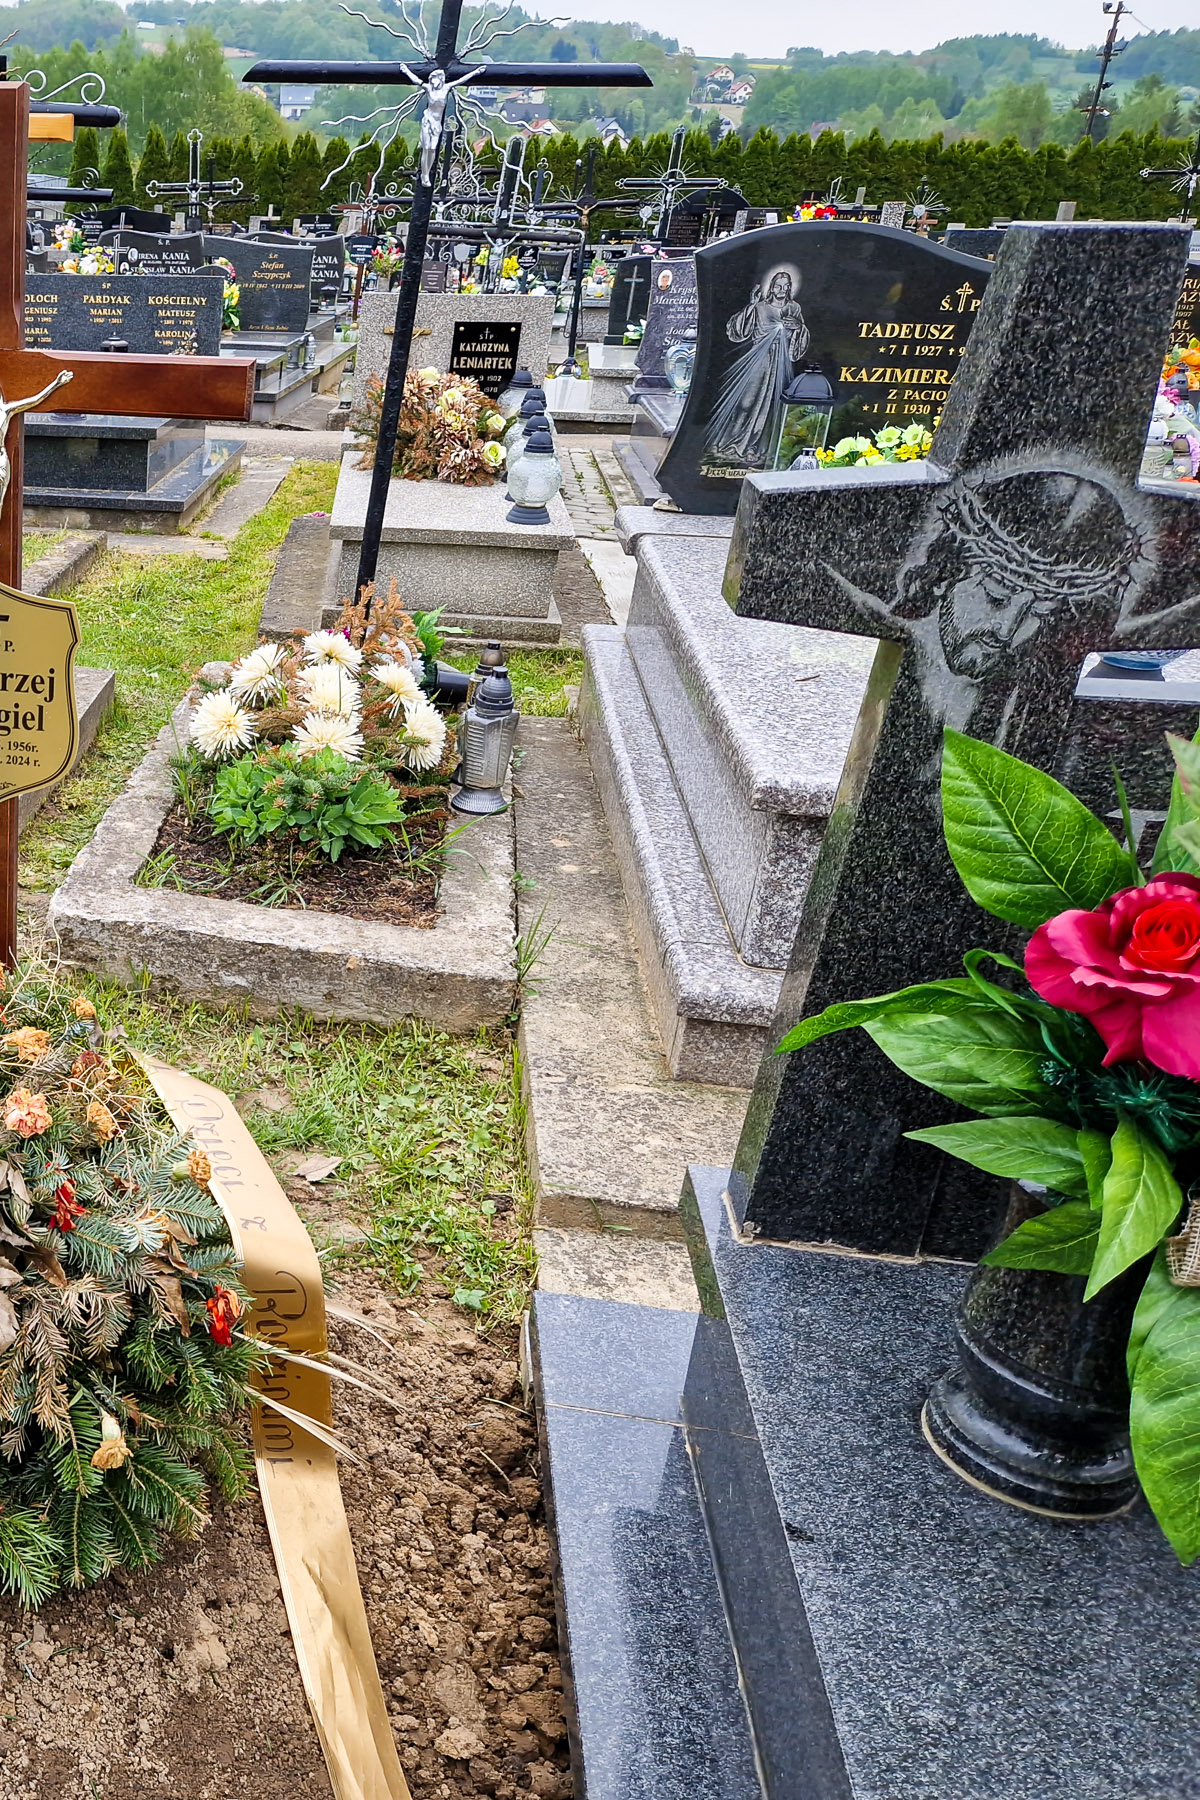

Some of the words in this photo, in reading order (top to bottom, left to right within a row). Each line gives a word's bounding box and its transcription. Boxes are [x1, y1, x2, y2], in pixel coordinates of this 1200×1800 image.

[162, 252, 190, 260] KANIA
[169, 265, 197, 275] KANIA
[260, 261, 284, 269] Stefan
[311, 269, 340, 278] KANIA
[83, 295, 131, 304] PARDYAK
[148, 294, 207, 305] KOŚCIELNY
[90, 308, 123, 316] MARIAN
[158, 309, 196, 318] MATEUSZ
[154, 330, 195, 339] KAROLIN
[858, 321, 957, 341] TADEUSZ
[459, 342, 510, 353] KATARZYNA
[888, 344, 897, 356] 7
[914, 345, 943, 357] 1927
[452, 356, 513, 370] LENIARTEK
[886, 388, 898, 400] Z
[903, 389, 948, 401] PACIO
[903, 404, 931, 415] 1930
[4, 640, 16, 652] P.
[5, 756, 30, 767] 2024
